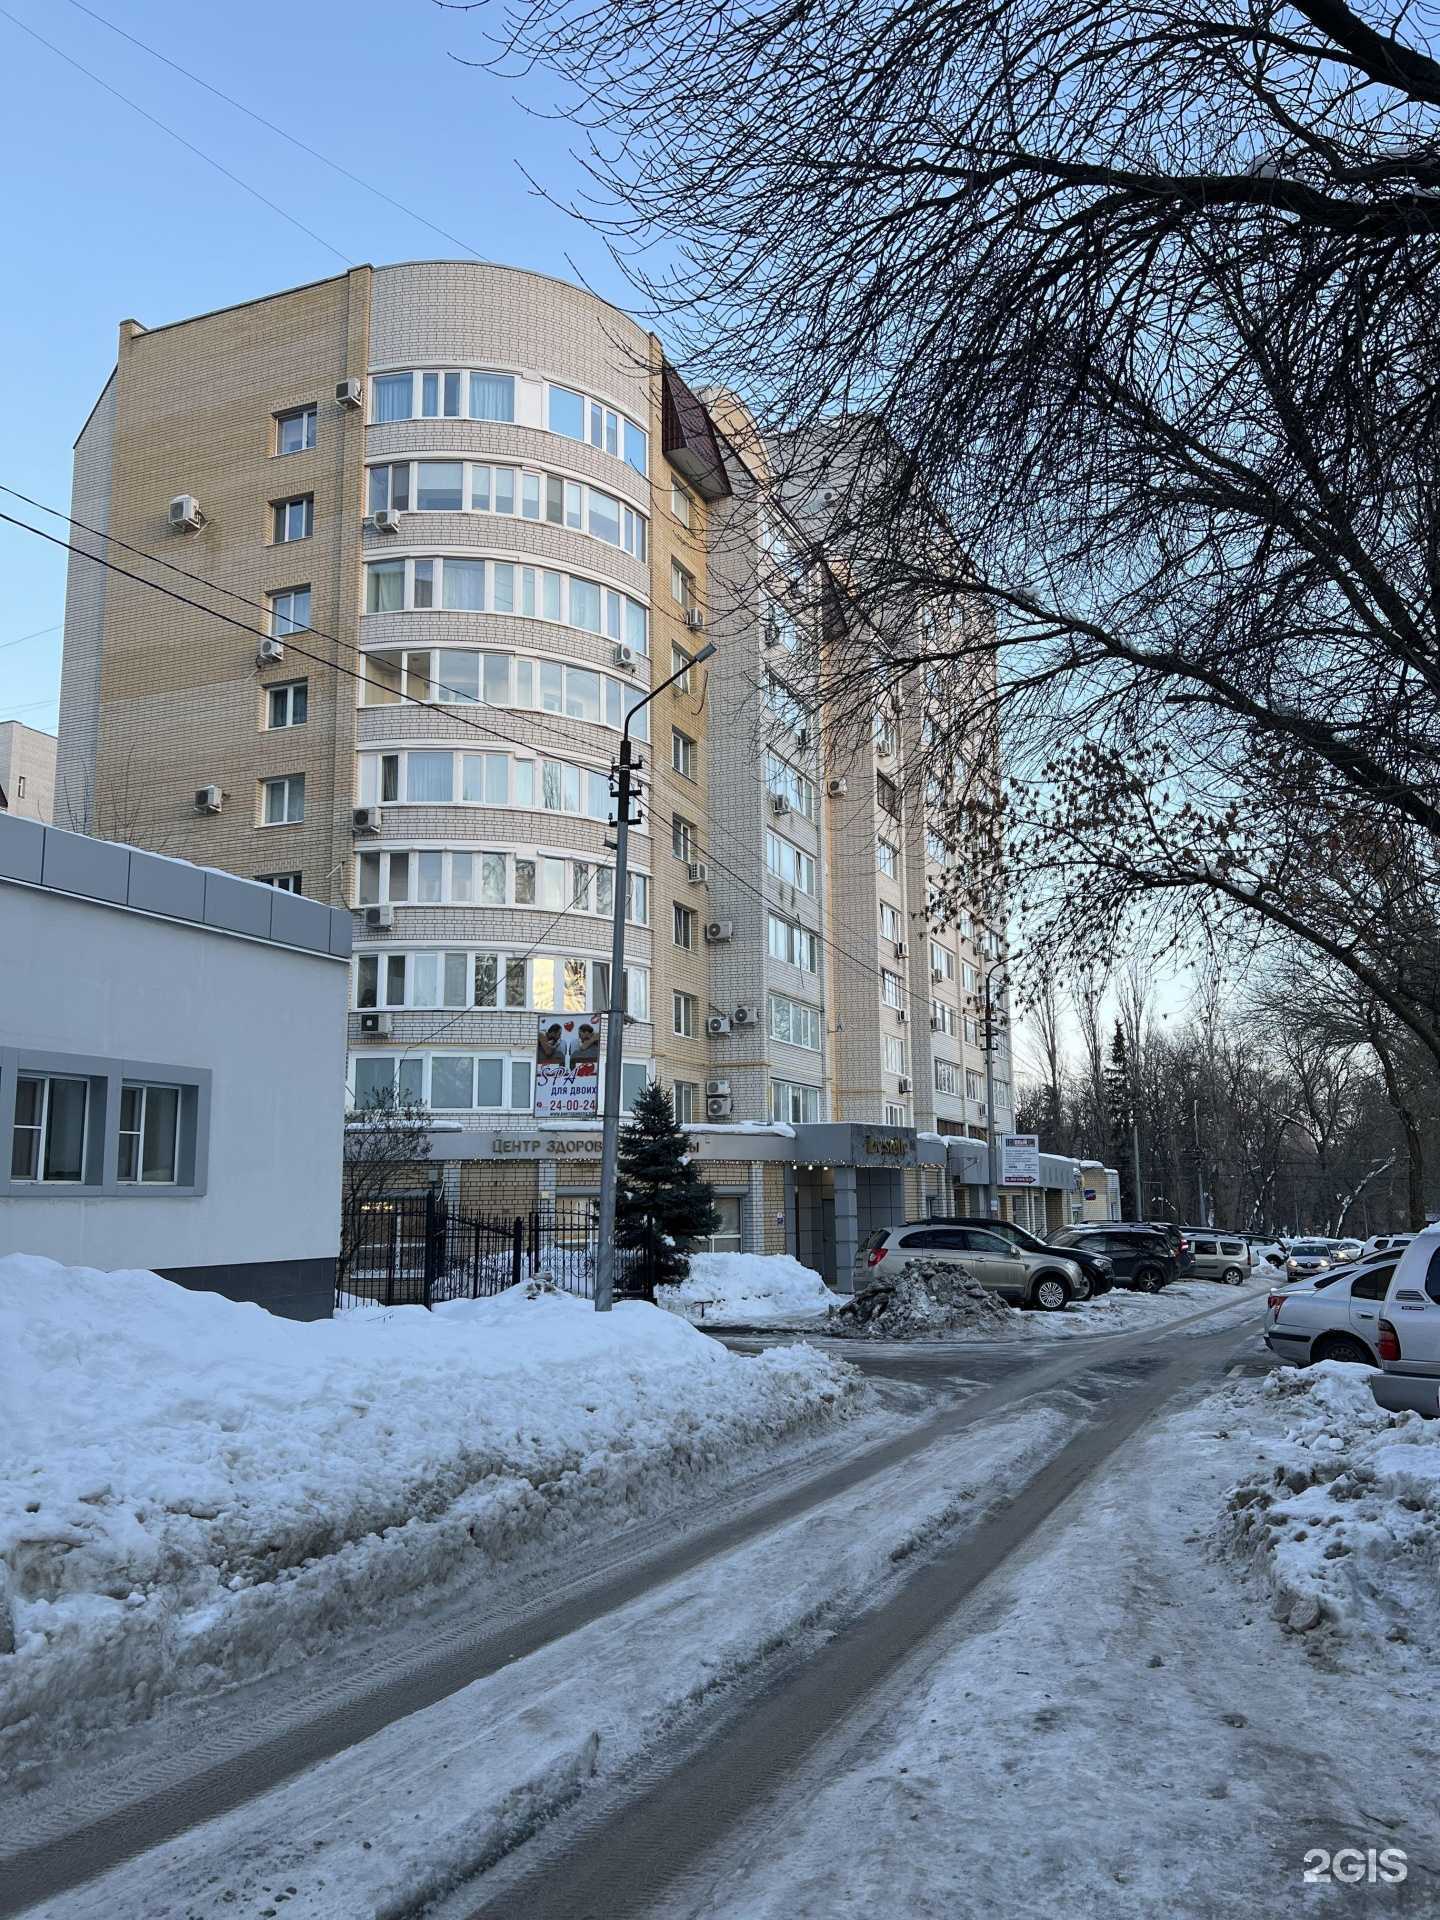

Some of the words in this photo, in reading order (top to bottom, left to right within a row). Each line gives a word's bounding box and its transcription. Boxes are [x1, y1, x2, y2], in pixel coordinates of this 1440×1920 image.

[538, 1067, 578, 1087] SPA
[551, 1086, 568, 1097] ДЛЯ
[570, 1086, 598, 1097] ДВОИХ
[550, 1099, 596, 1111] 24-00-24
[492, 1139, 541, 1154] ЦЕНТР
[547, 1140, 603, 1154] ЗДОРОВ
